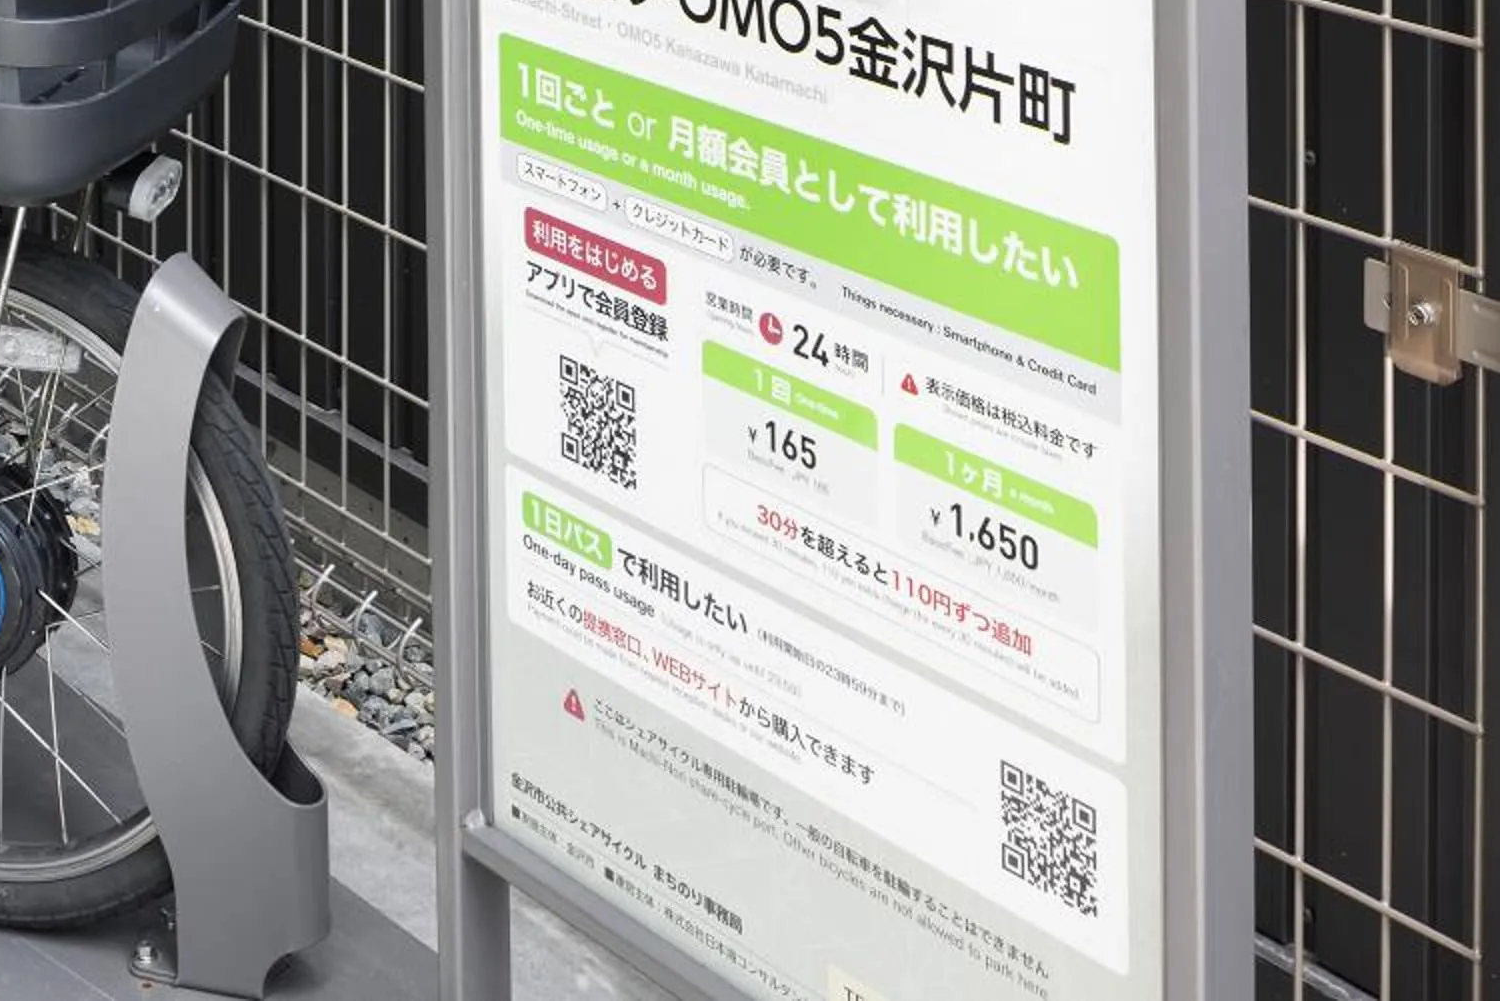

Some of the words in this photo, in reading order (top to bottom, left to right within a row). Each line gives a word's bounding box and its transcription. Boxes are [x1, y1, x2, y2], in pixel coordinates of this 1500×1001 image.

[616, 21, 661, 50] OMO5
[665, 37, 741, 77] Kanazawa
[745, 61, 828, 105] Katamachi
[515, 108, 575, 146] One-time
[578, 135, 619, 162] usage
[622, 150, 635, 168] or
[639, 161, 649, 174] a
[652, 161, 697, 190] month
[523, 161, 602, 202] スマートフォン
[631, 202, 730, 251] クレジットカード
[739, 246, 818, 289] が必要です。
[627, 111, 658, 142] or
[668, 114, 1079, 290] 月額会員として利用したい
[531, 218, 657, 291] 利用をはじめる
[526, 260, 669, 342] アプリで会員登録
[841, 285, 877, 310] Things
[879, 303, 934, 334] necessary
[943, 326, 1013, 364] Smartphone
[1016, 355, 1026, 368] &
[1028, 359, 1065, 384] Credit
[1067, 374, 1098, 397] Card
[925, 376, 1098, 459] 表示価格は税込料金です
[522, 533, 576, 577] One-day
[579, 567, 611, 594] pass
[613, 586, 656, 618] usage
[530, 498, 605, 561] 1日パス
[617, 547, 748, 635] で利用したい
[756, 504, 1033, 657] 30分を超えると110円ずつ追加
